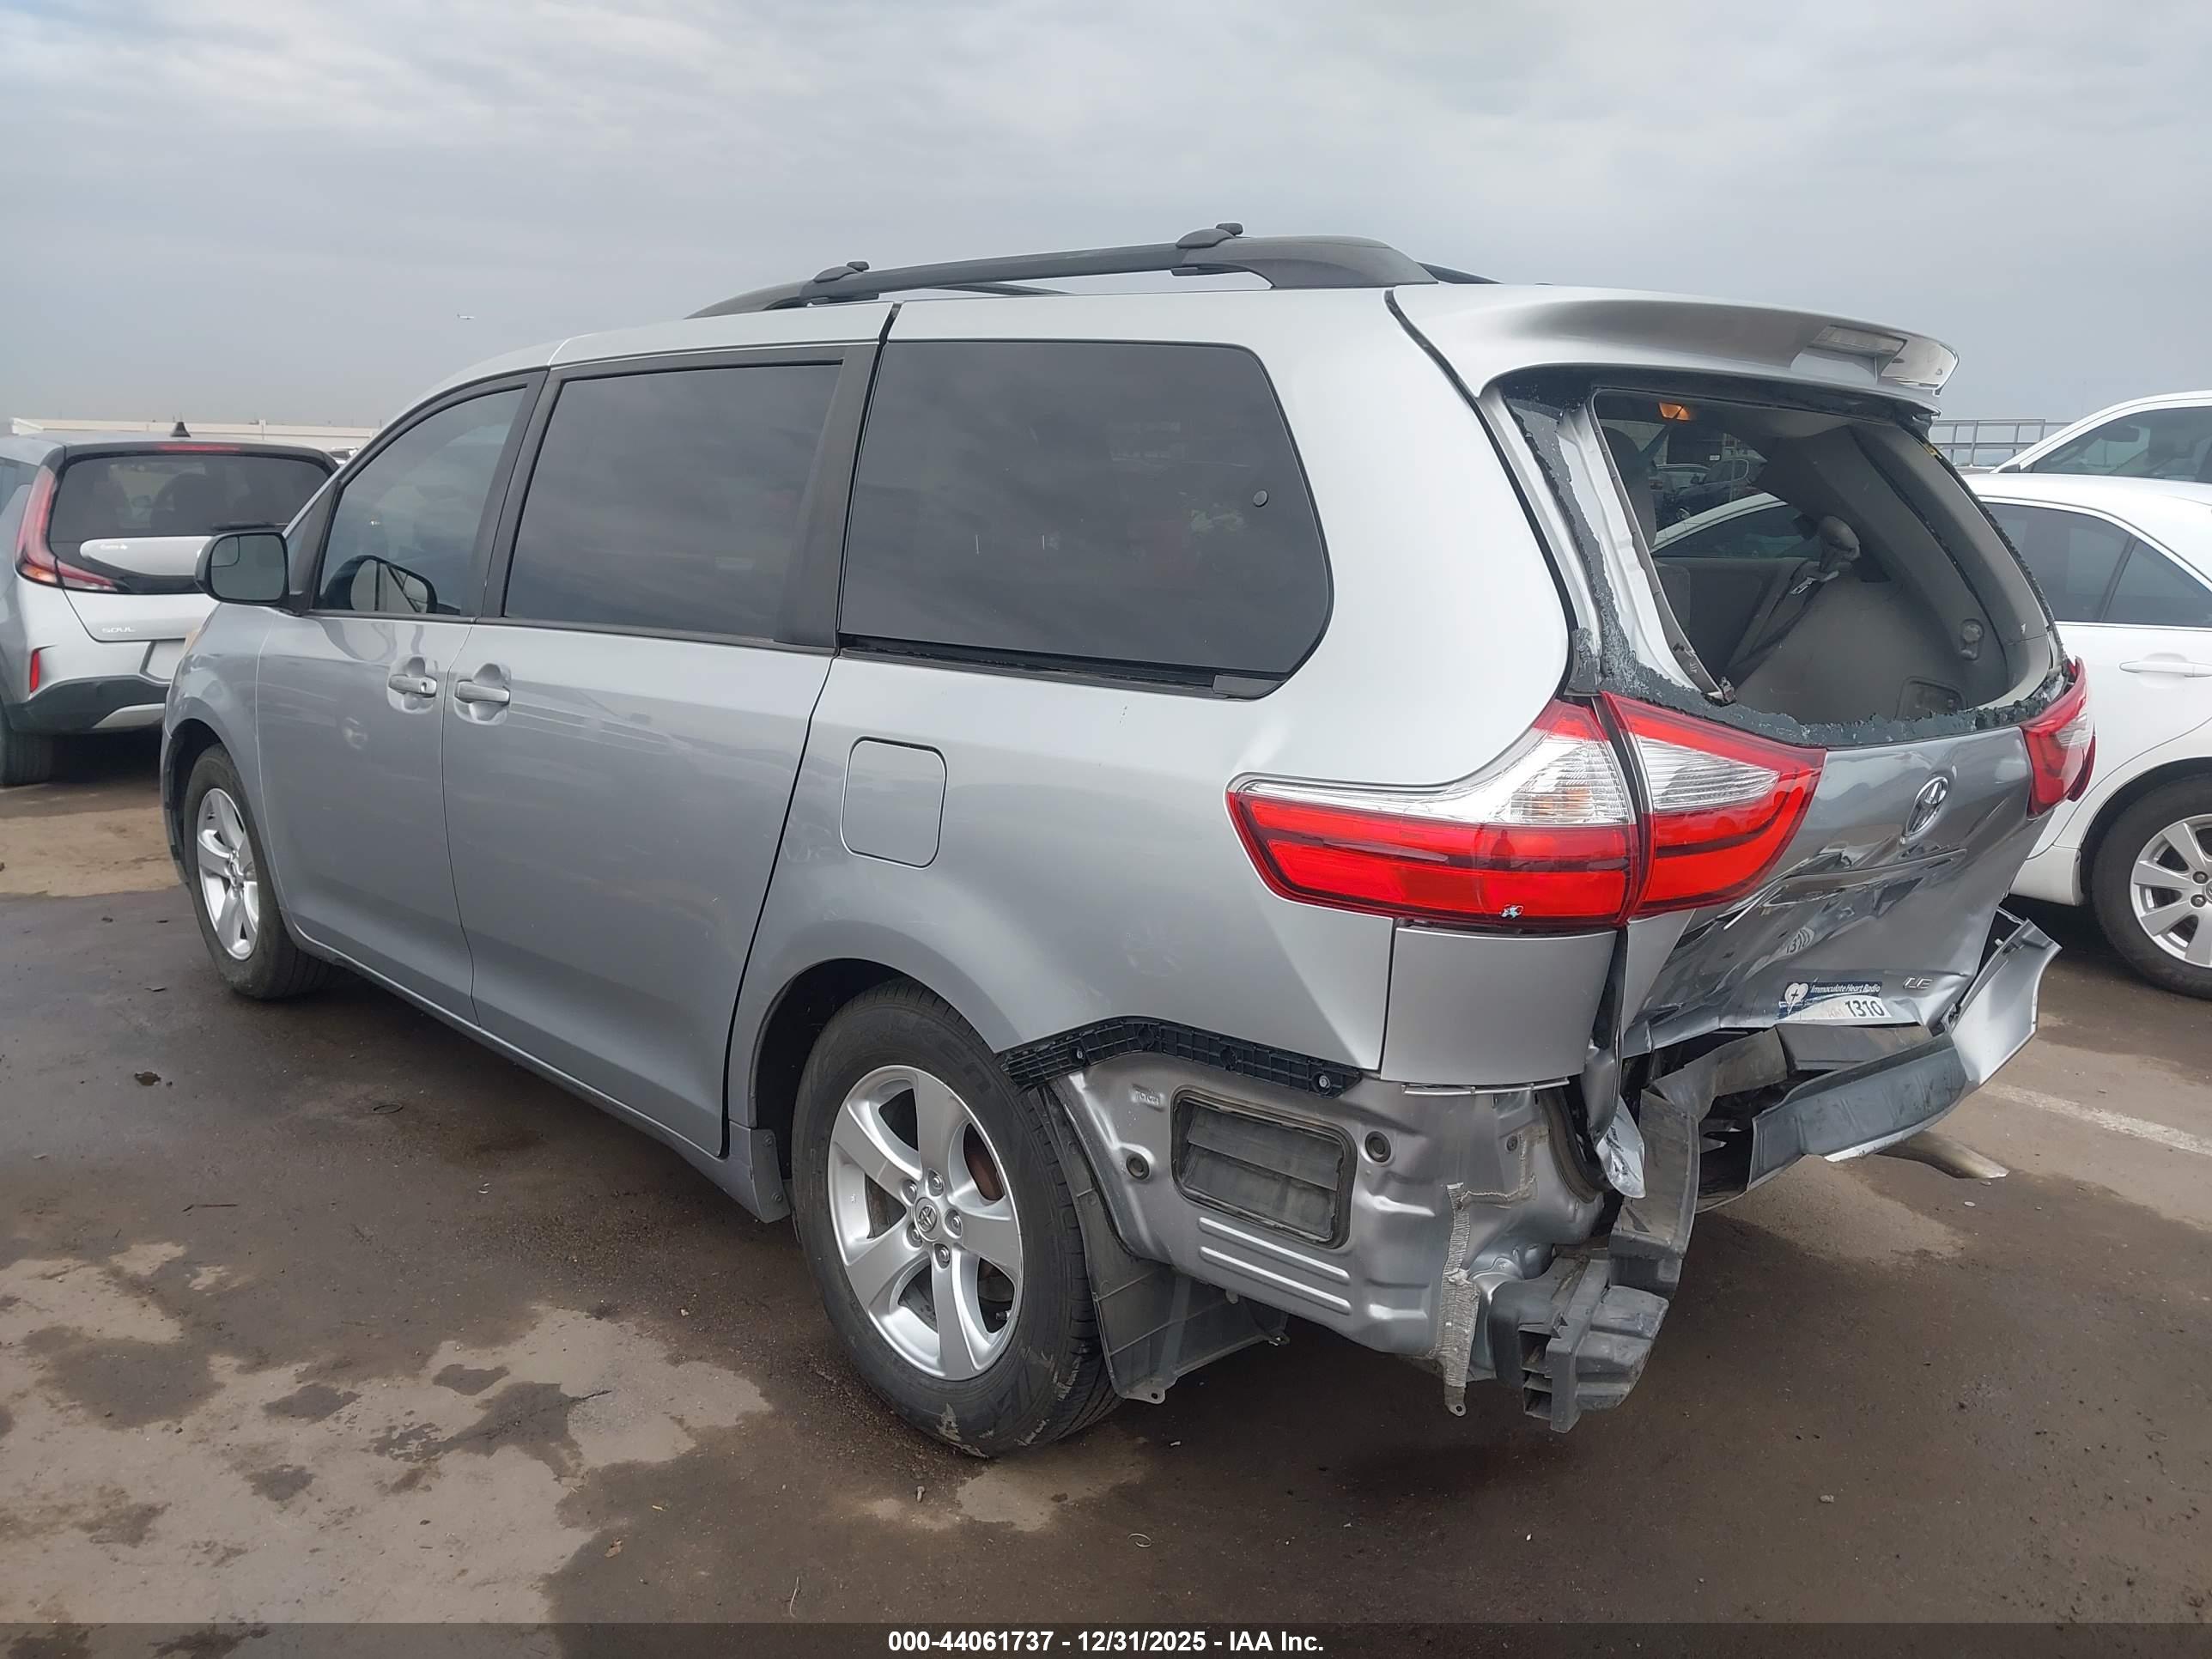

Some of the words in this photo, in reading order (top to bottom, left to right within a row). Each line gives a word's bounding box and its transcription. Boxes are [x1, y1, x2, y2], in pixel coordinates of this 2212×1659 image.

[1810, 983, 1846, 993] Immaculate
[1845, 983, 1863, 993] Heart
[1863, 983, 1881, 993] Radio
[1902, 976, 1933, 989] LE
[1845, 1000, 1885, 1018] 1310
